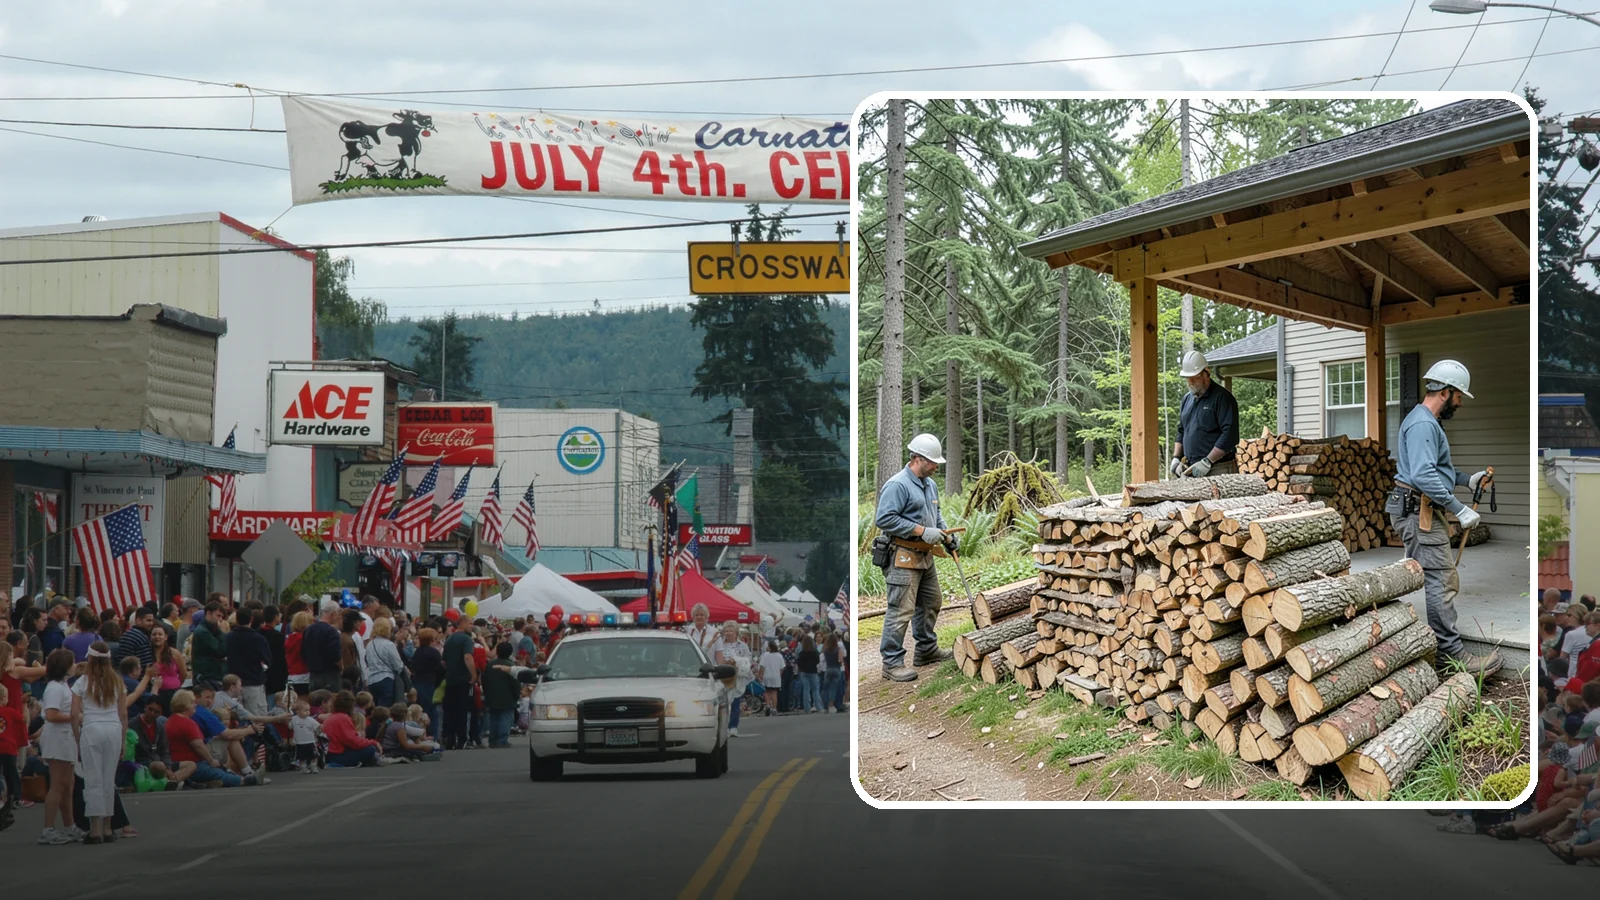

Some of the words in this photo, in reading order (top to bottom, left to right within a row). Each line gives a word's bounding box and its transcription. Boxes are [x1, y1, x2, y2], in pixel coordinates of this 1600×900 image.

[481, 141, 604, 192] JULY
[632, 150, 746, 198] 4th.
[697, 254, 850, 280] CROSSWA
[283, 380, 373, 420] ACE
[405, 409, 453, 422] CEDAR
[461, 409, 485, 421] LOG
[283, 421, 371, 437] Hardware
[416, 428, 477, 447] Coca-Cola
[353, 467, 386, 481] Simpl
[96, 485, 124, 494] Vincent
[126, 486, 136, 494] de
[137, 486, 155, 495] Paul
[688, 526, 741, 535] CRNATION
[699, 535, 730, 543] GLASS
